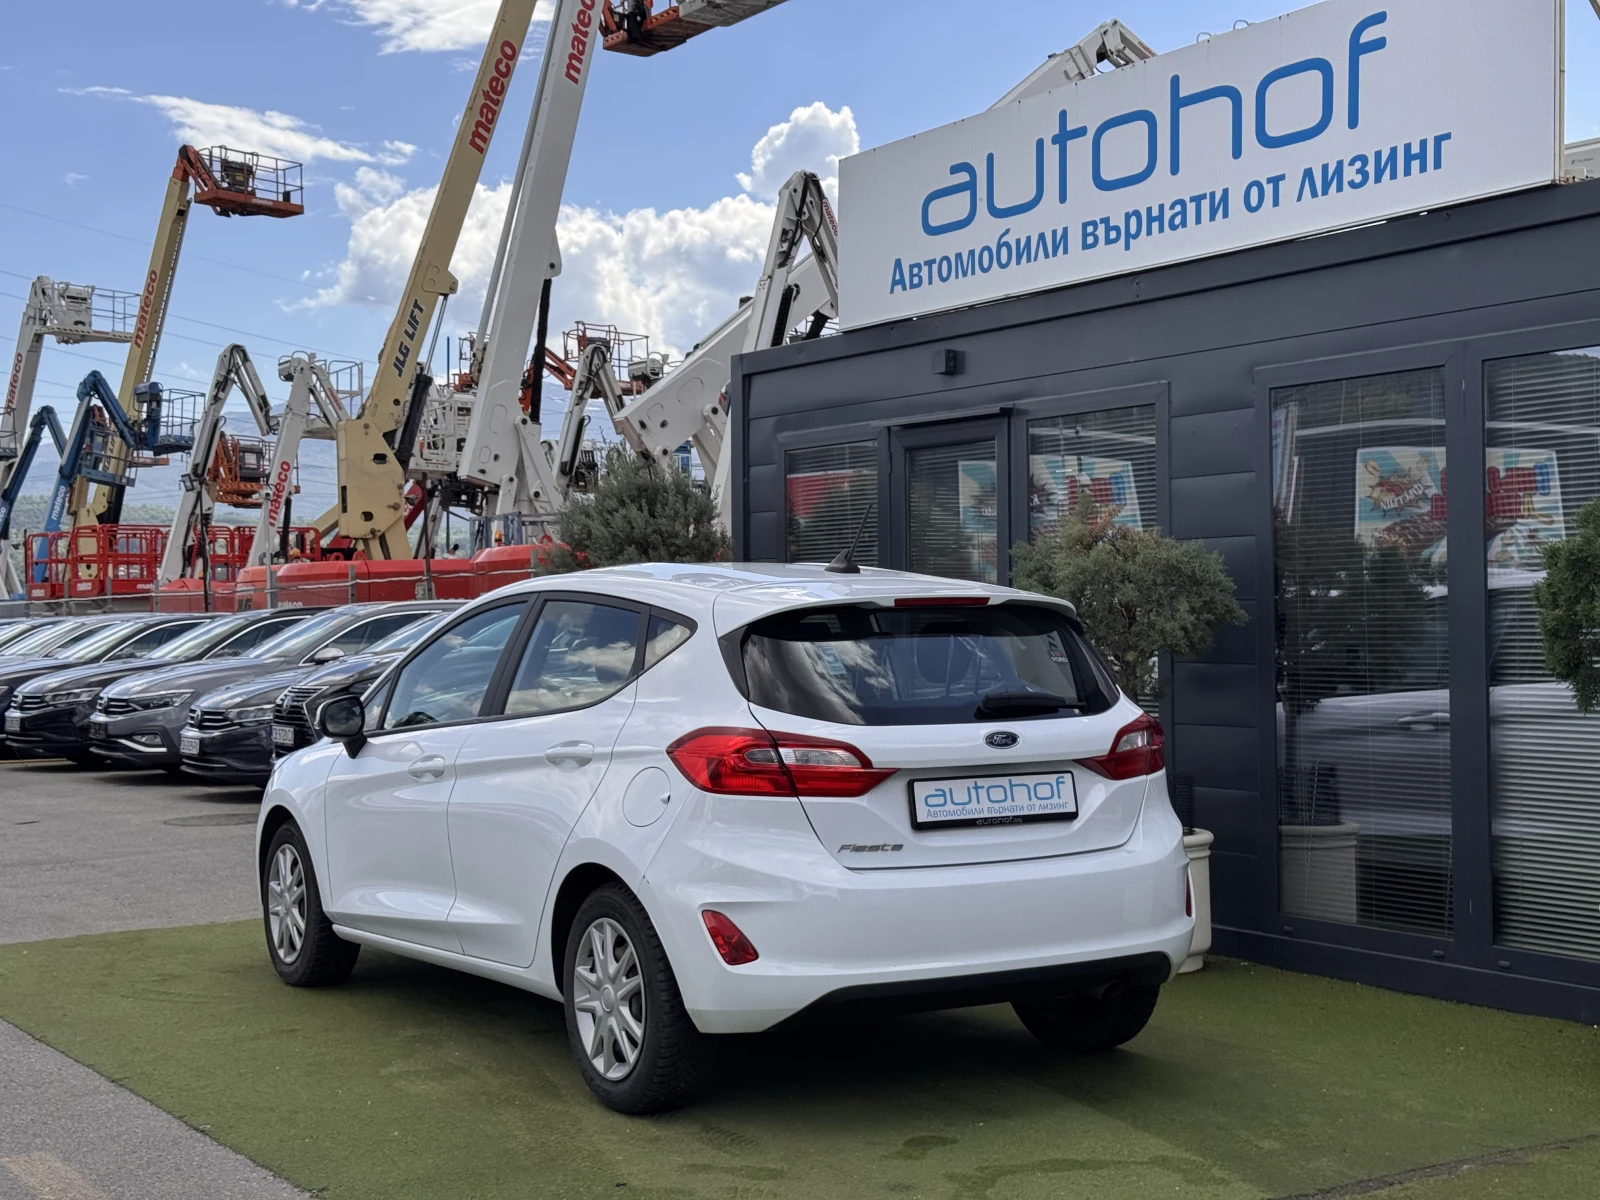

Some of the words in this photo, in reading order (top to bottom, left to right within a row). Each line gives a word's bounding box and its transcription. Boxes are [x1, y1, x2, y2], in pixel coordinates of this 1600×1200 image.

[564, 0, 596, 86] matec
[469, 39, 517, 155] mateco
[921, 11, 1387, 236] autohof
[889, 228, 1069, 295] Автомобили
[1081, 187, 1230, 251] върнати
[1243, 173, 1286, 213] от
[1296, 132, 1452, 203] лизинг
[134, 269, 157, 348] mateco
[392, 341, 411, 378] JLG
[403, 298, 425, 342] LIFT
[7, 352, 23, 416] mateco
[51, 485, 66, 520] mateco
[269, 460, 291, 528] mateco
[924, 775, 1066, 808] autohof
[926, 805, 985, 819] Автомобили
[987, 803, 1024, 815] върнати
[1026, 803, 1037, 812] от
[1038, 801, 1069, 812] лизинг
[837, 843, 904, 853] Fiesta
